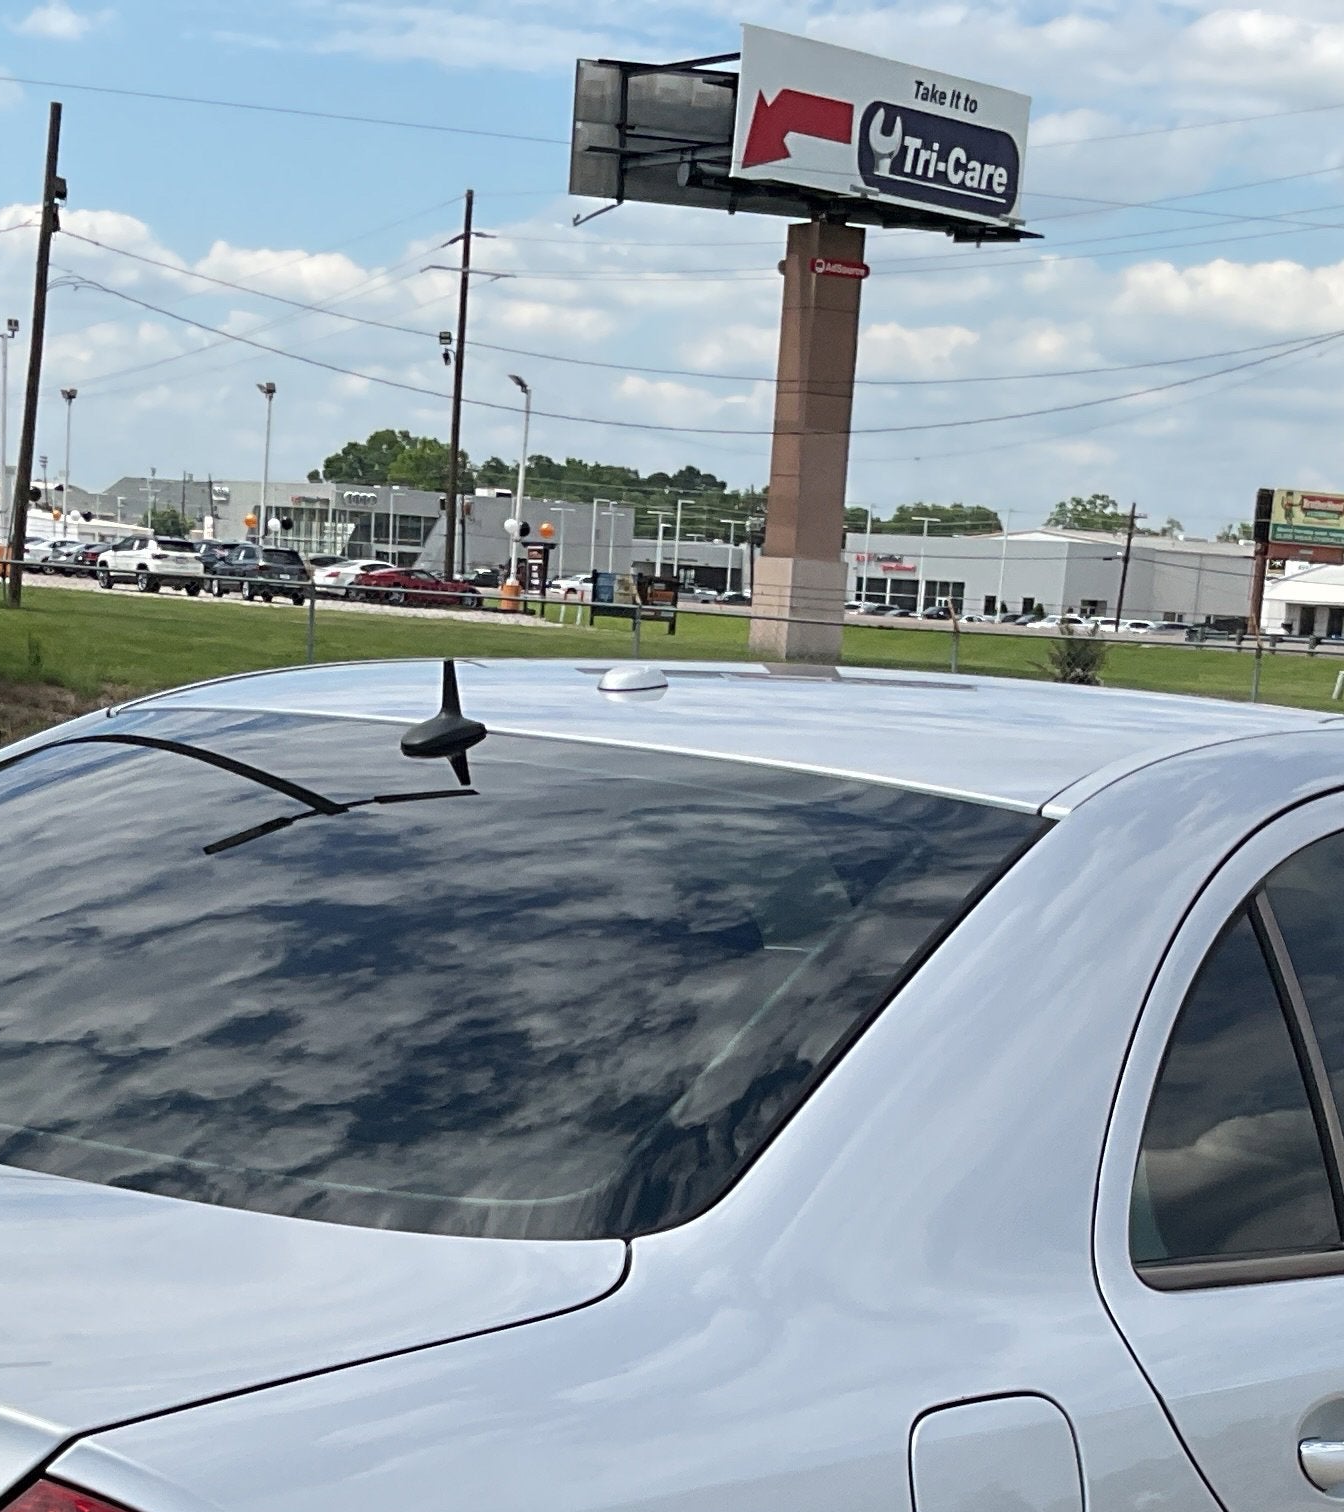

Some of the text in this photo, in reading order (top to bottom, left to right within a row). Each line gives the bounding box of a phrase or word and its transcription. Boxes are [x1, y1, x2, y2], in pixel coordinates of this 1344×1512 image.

[914, 79, 947, 106] Take
[963, 93, 978, 114] to
[903, 135, 1008, 194] Tri-Care
